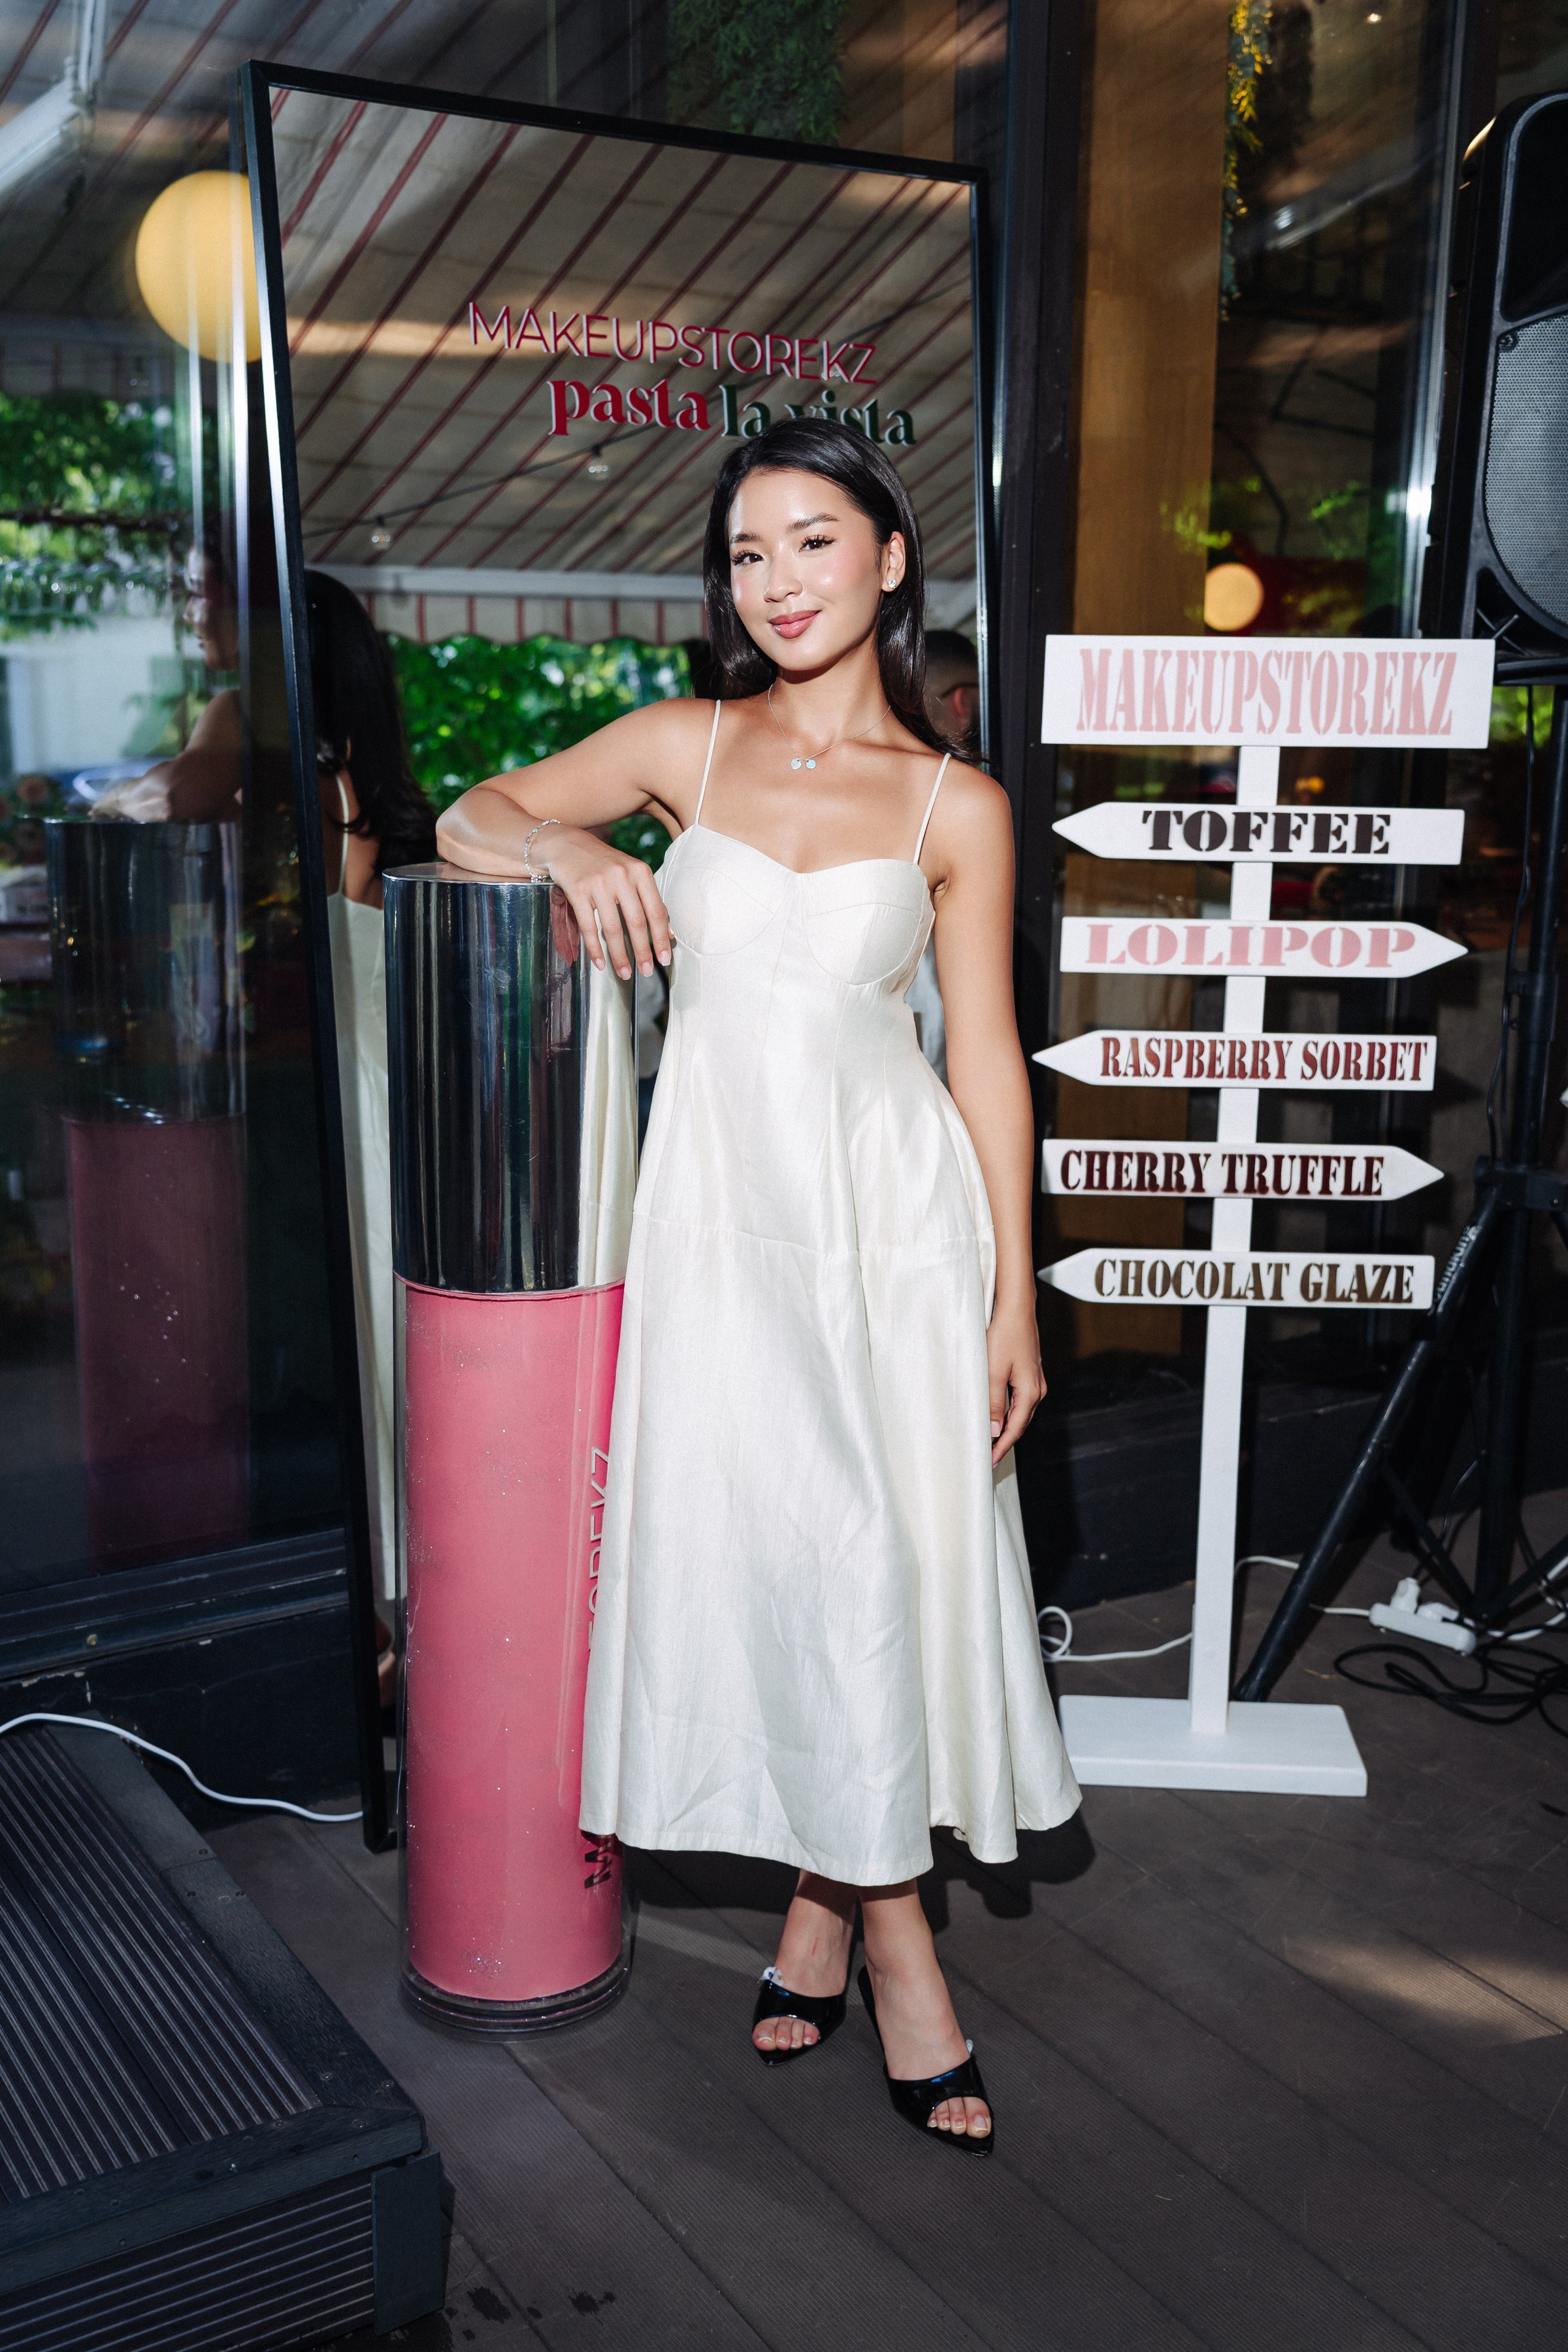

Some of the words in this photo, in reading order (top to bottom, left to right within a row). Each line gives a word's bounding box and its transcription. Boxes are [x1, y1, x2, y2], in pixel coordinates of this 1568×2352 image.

[468, 302, 877, 385] MAKEUPSTOREKZ
[547, 379, 710, 436] pasta
[719, 384, 771, 439] la
[1076, 649, 1457, 736] MAKEUPSTOREKZ
[1142, 810, 1391, 855] TOFFEE
[1086, 924, 1416, 968] LOLIPOP
[1100, 1037, 1293, 1080] RASPBERRY
[1301, 1041, 1428, 1081] SORBET
[1060, 1150, 1211, 1194] CHERRY
[1222, 1154, 1384, 1196] TRUFFLE
[1094, 1259, 1290, 1301] CHOCOLAT
[1299, 1264, 1414, 1303] GLAZE
